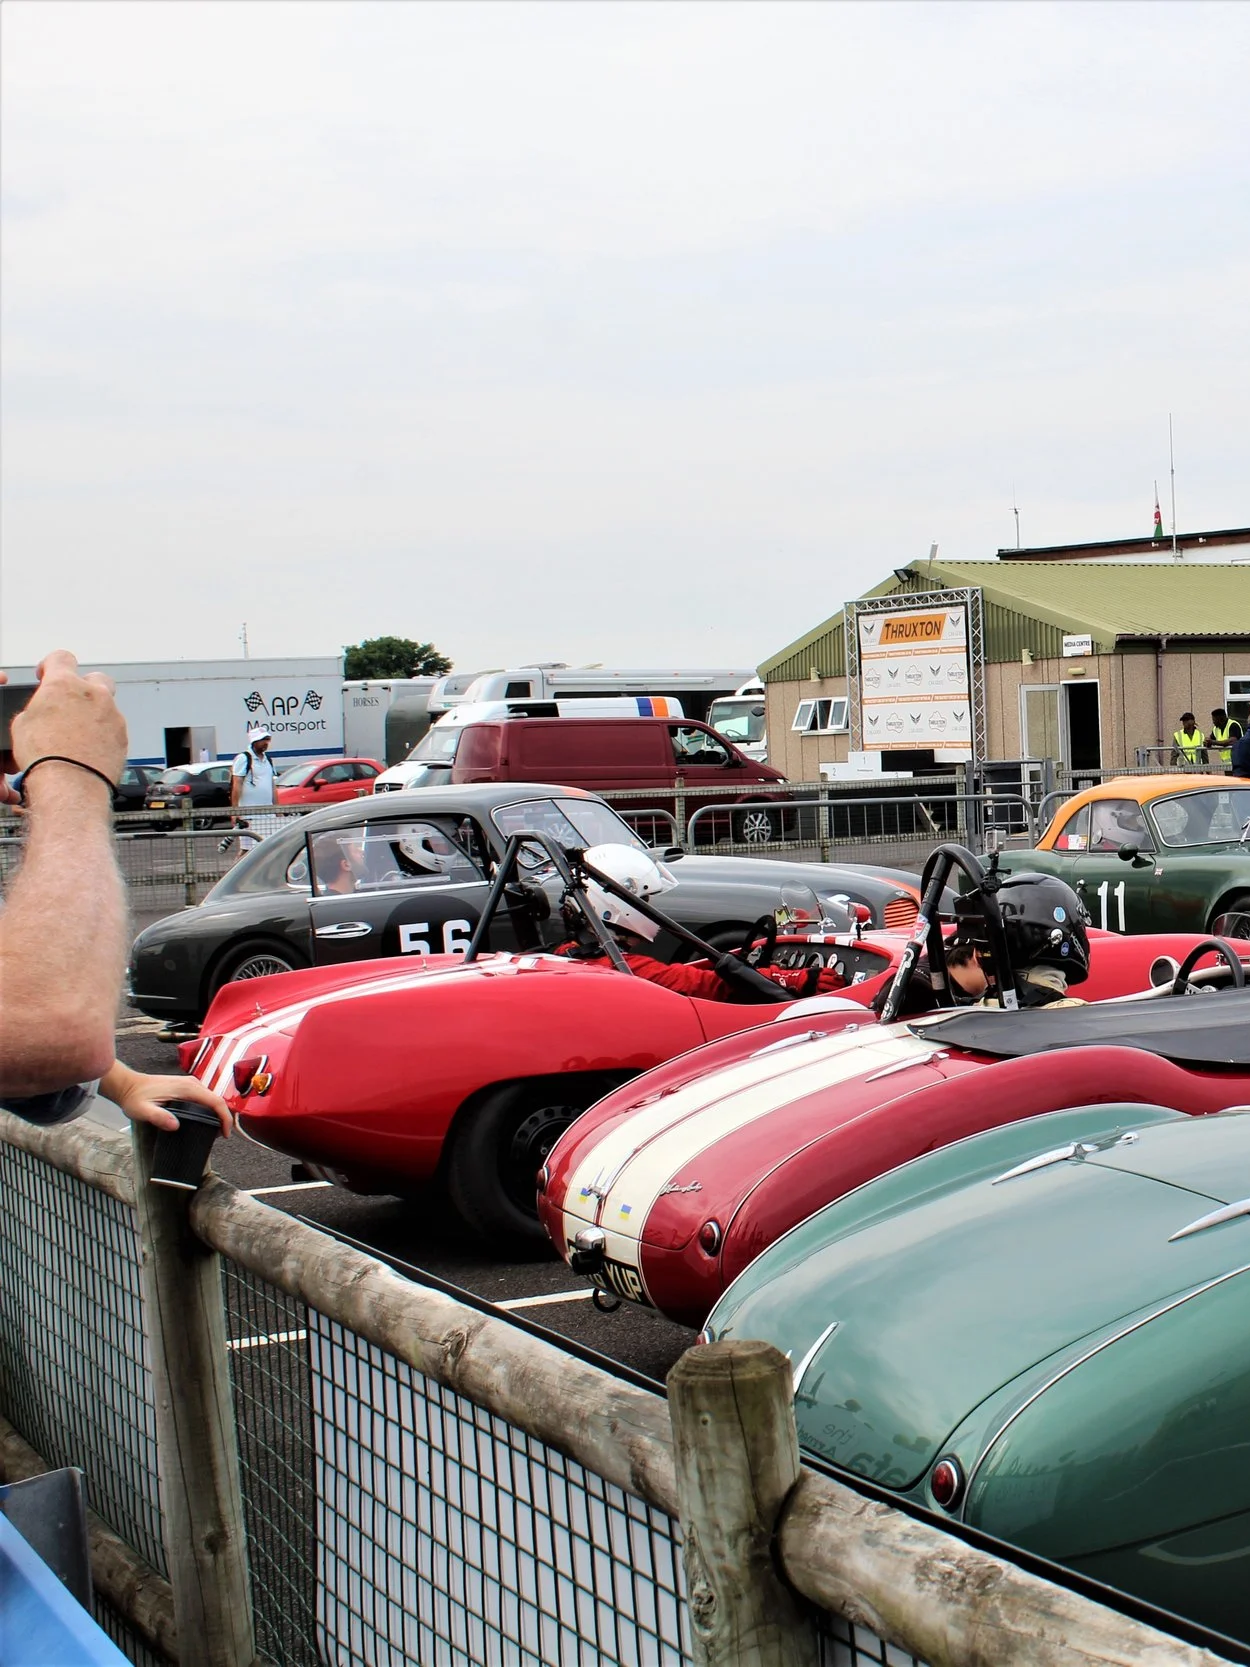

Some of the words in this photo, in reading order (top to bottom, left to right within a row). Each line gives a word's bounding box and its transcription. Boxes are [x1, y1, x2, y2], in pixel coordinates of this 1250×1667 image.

[885, 620, 941, 639] THRUXTON
[272, 696, 299, 716] AP
[1097, 880, 1126, 931] 11
[399, 919, 471, 954] 56
[603, 1261, 643, 1302] YUP
